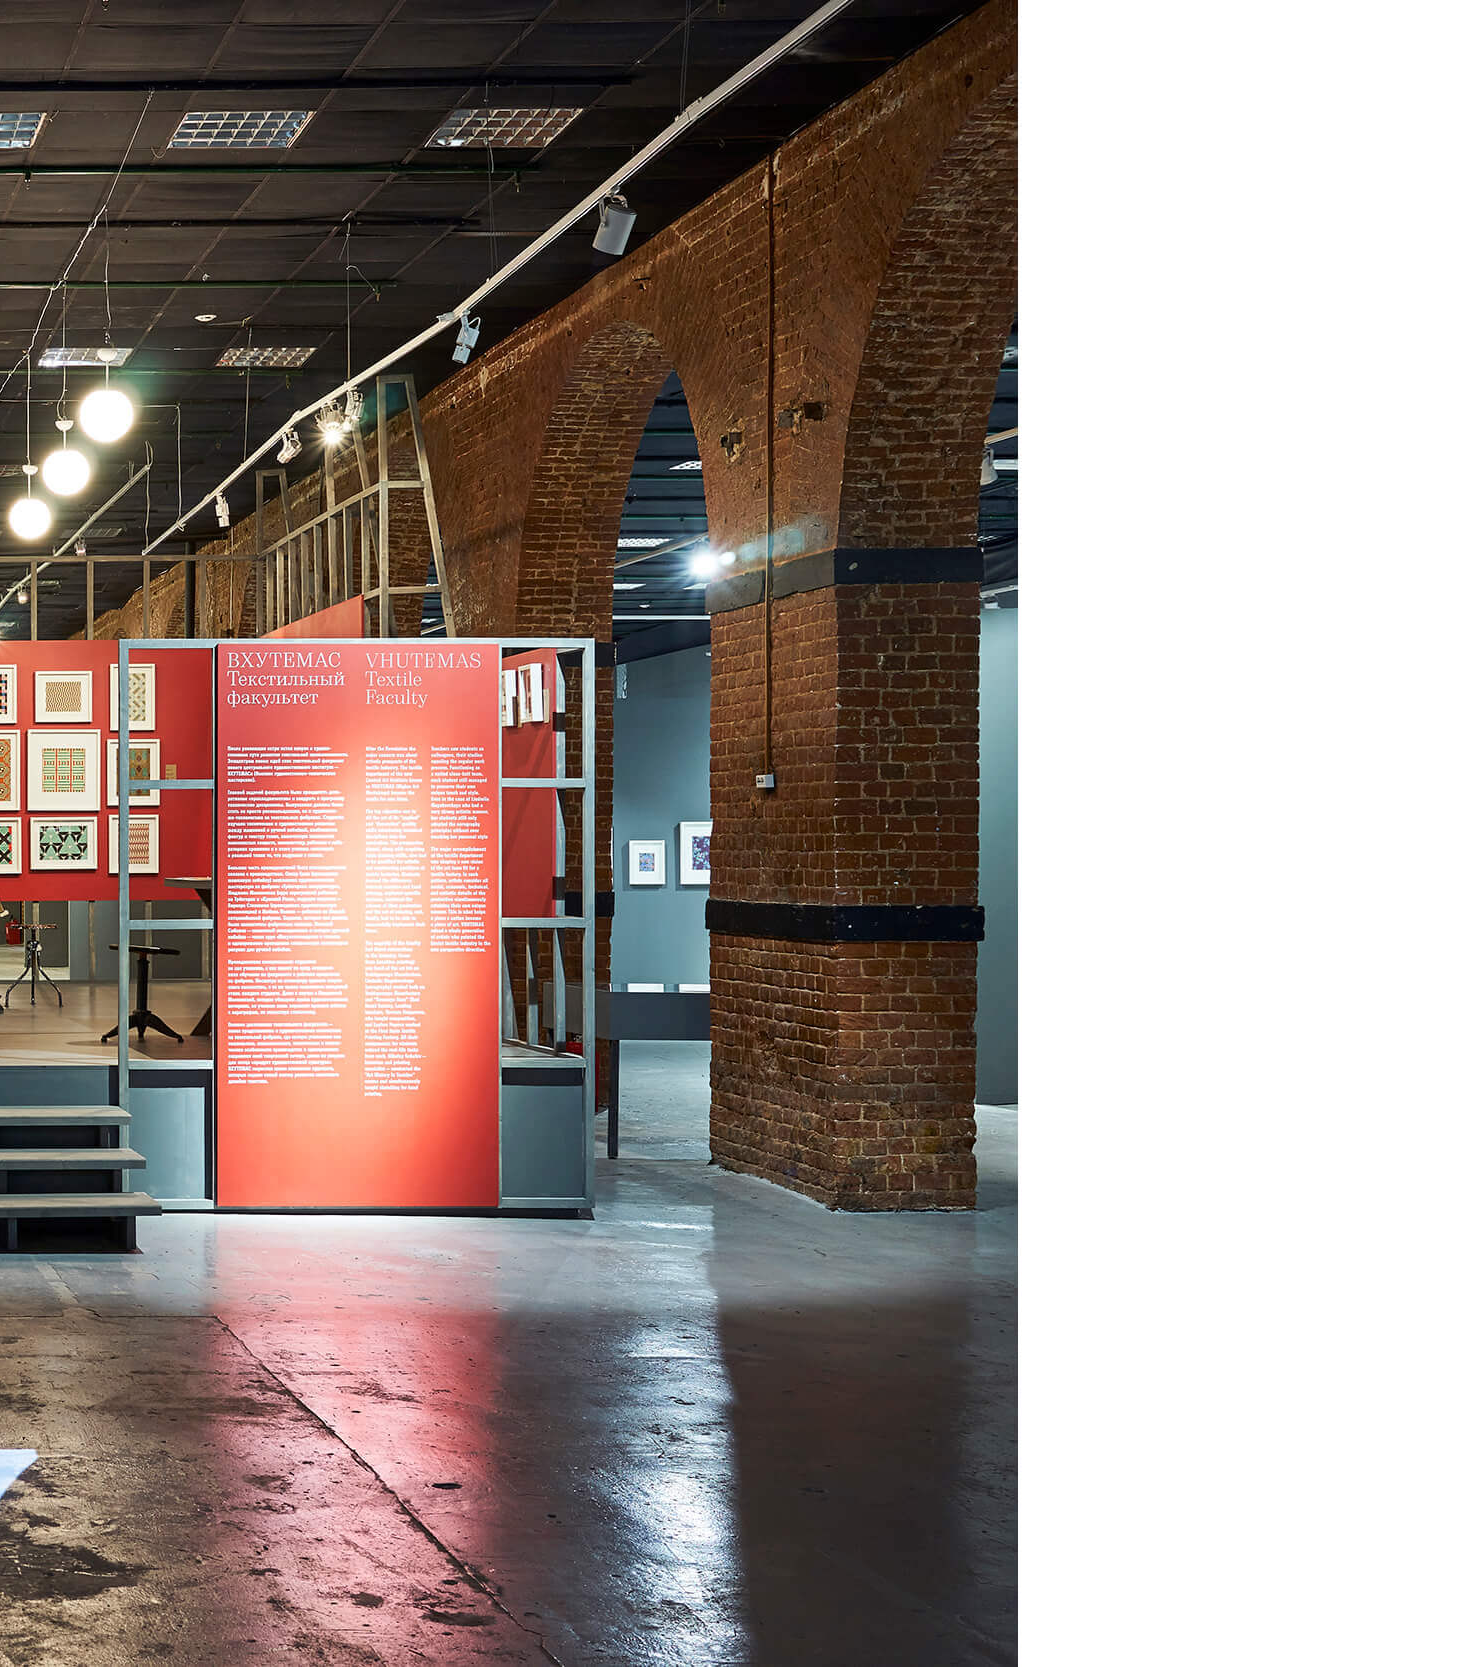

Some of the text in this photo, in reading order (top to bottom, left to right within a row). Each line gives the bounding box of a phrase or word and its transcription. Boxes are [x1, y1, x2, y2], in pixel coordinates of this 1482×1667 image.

[226, 652, 341, 668] ВХУТЕМАС
[365, 652, 482, 669] VHUTEMAS
[226, 670, 345, 686] Текстильный
[365, 671, 422, 686] Textile
[226, 690, 319, 708] факультет
[365, 689, 428, 708] Faculty
